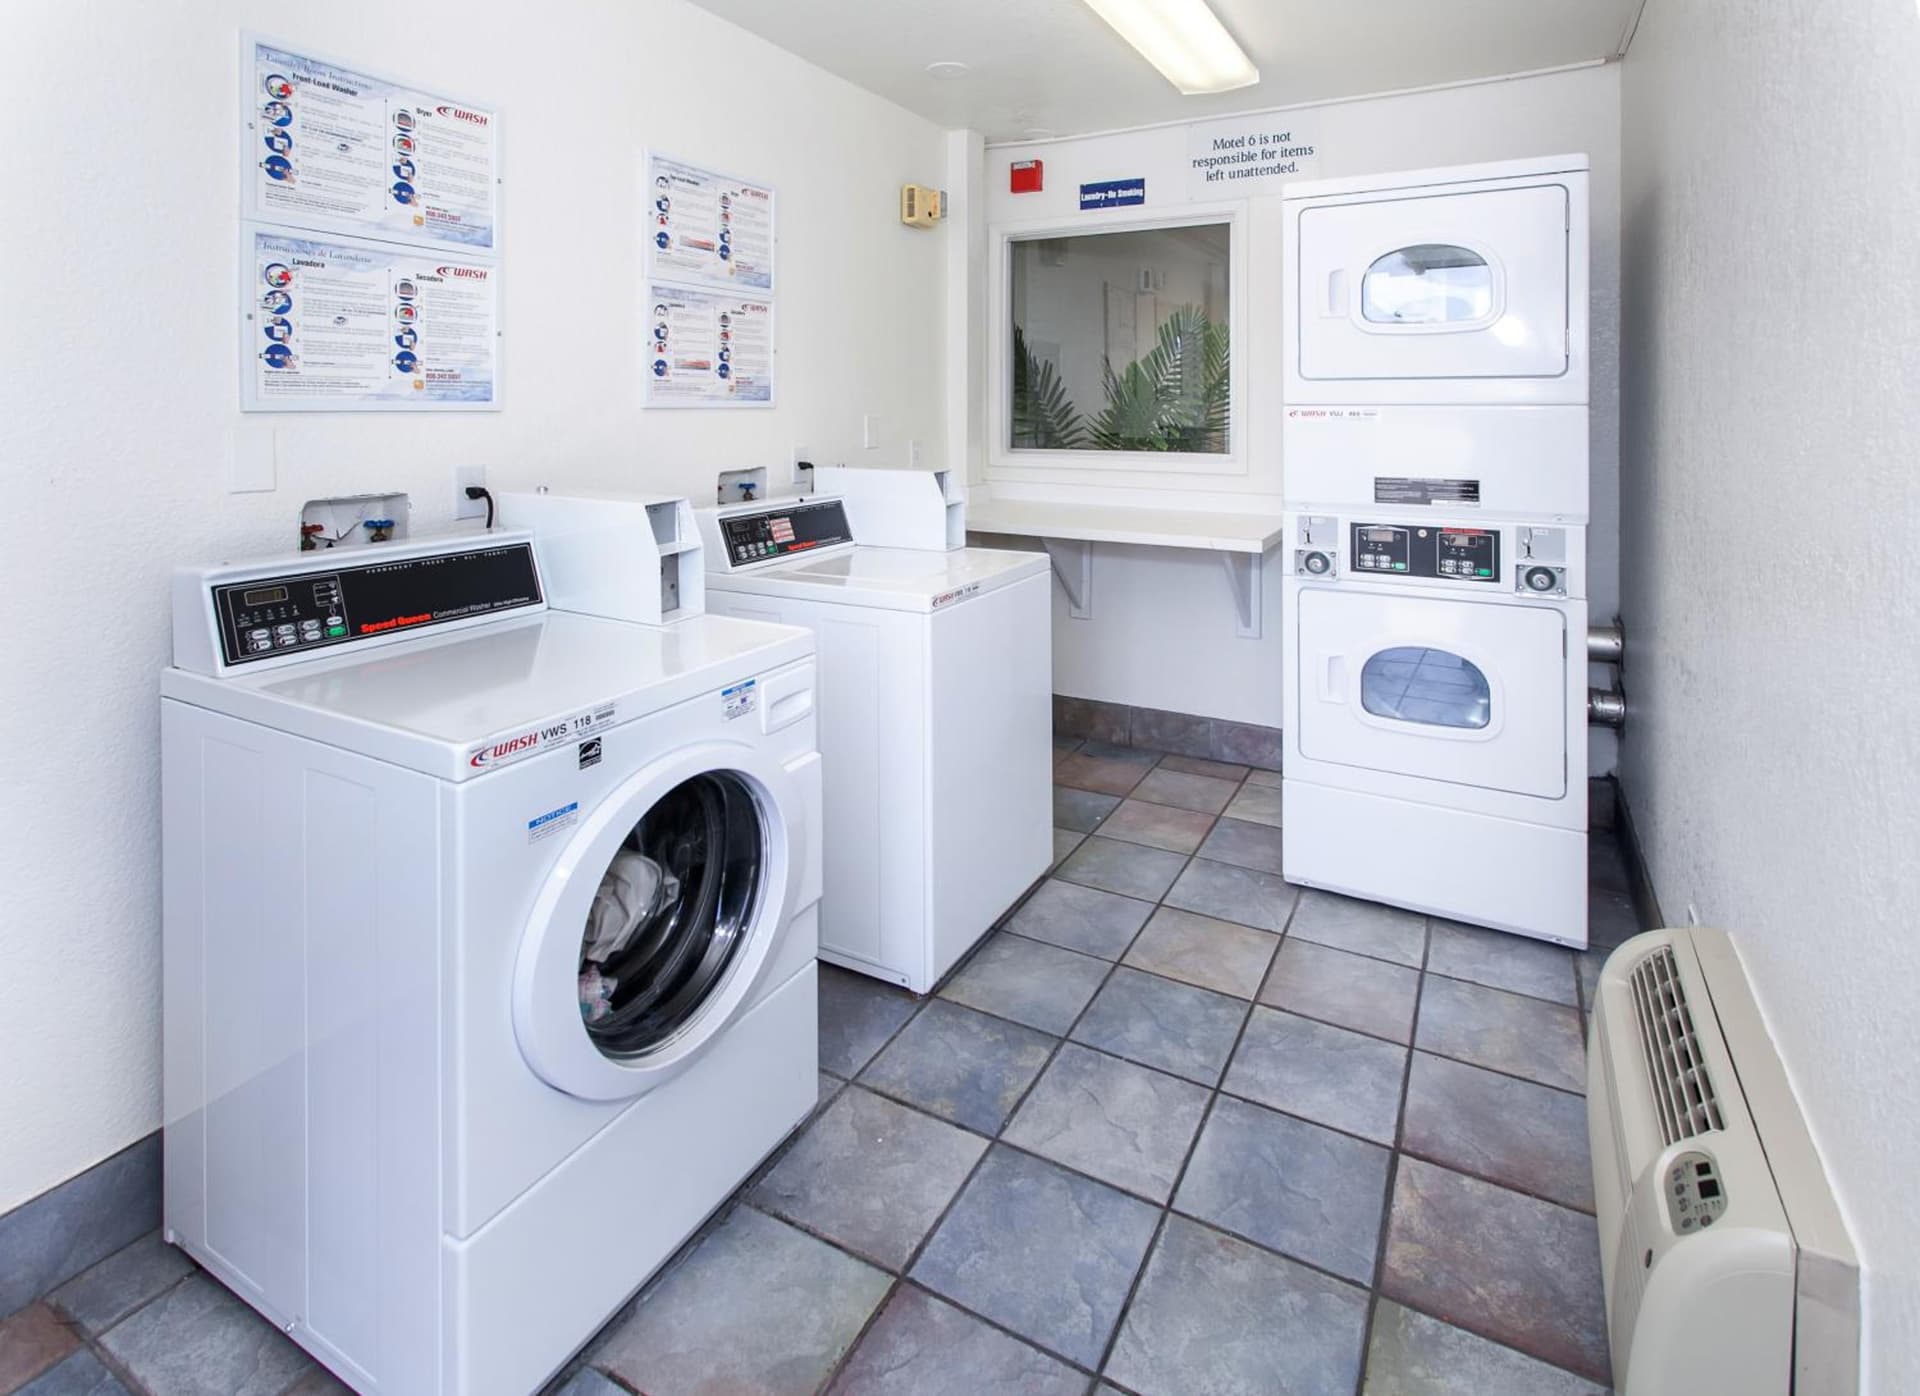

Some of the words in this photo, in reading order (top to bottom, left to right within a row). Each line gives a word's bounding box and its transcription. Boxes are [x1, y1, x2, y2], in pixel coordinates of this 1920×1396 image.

[332, 84, 358, 96] Washer
[416, 107, 433, 117] Dryer
[454, 109, 488, 126] WASH
[1212, 136, 1245, 151] Motel
[1248, 134, 1256, 146] 6
[1259, 133, 1269, 145] is
[1272, 131, 1291, 144] not
[1192, 150, 1258, 169] responsible
[1260, 148, 1278, 161] for
[1280, 145, 1314, 159] items
[1206, 171, 1224, 182] left
[1228, 161, 1299, 180] unattended.
[750, 190, 769, 200] WASH
[1117, 187, 1143, 198] Smoking
[292, 257, 325, 269] Lavadora
[415, 273, 443, 283] Secadora
[454, 267, 488, 280] WASH
[360, 618, 397, 634] Speed
[397, 613, 432, 626] Queen
[433, 606, 469, 619] Commercial
[469, 602, 491, 612] Washer
[493, 731, 539, 758] WASH
[541, 722, 568, 741] VWS
[573, 714, 593, 730] 118
